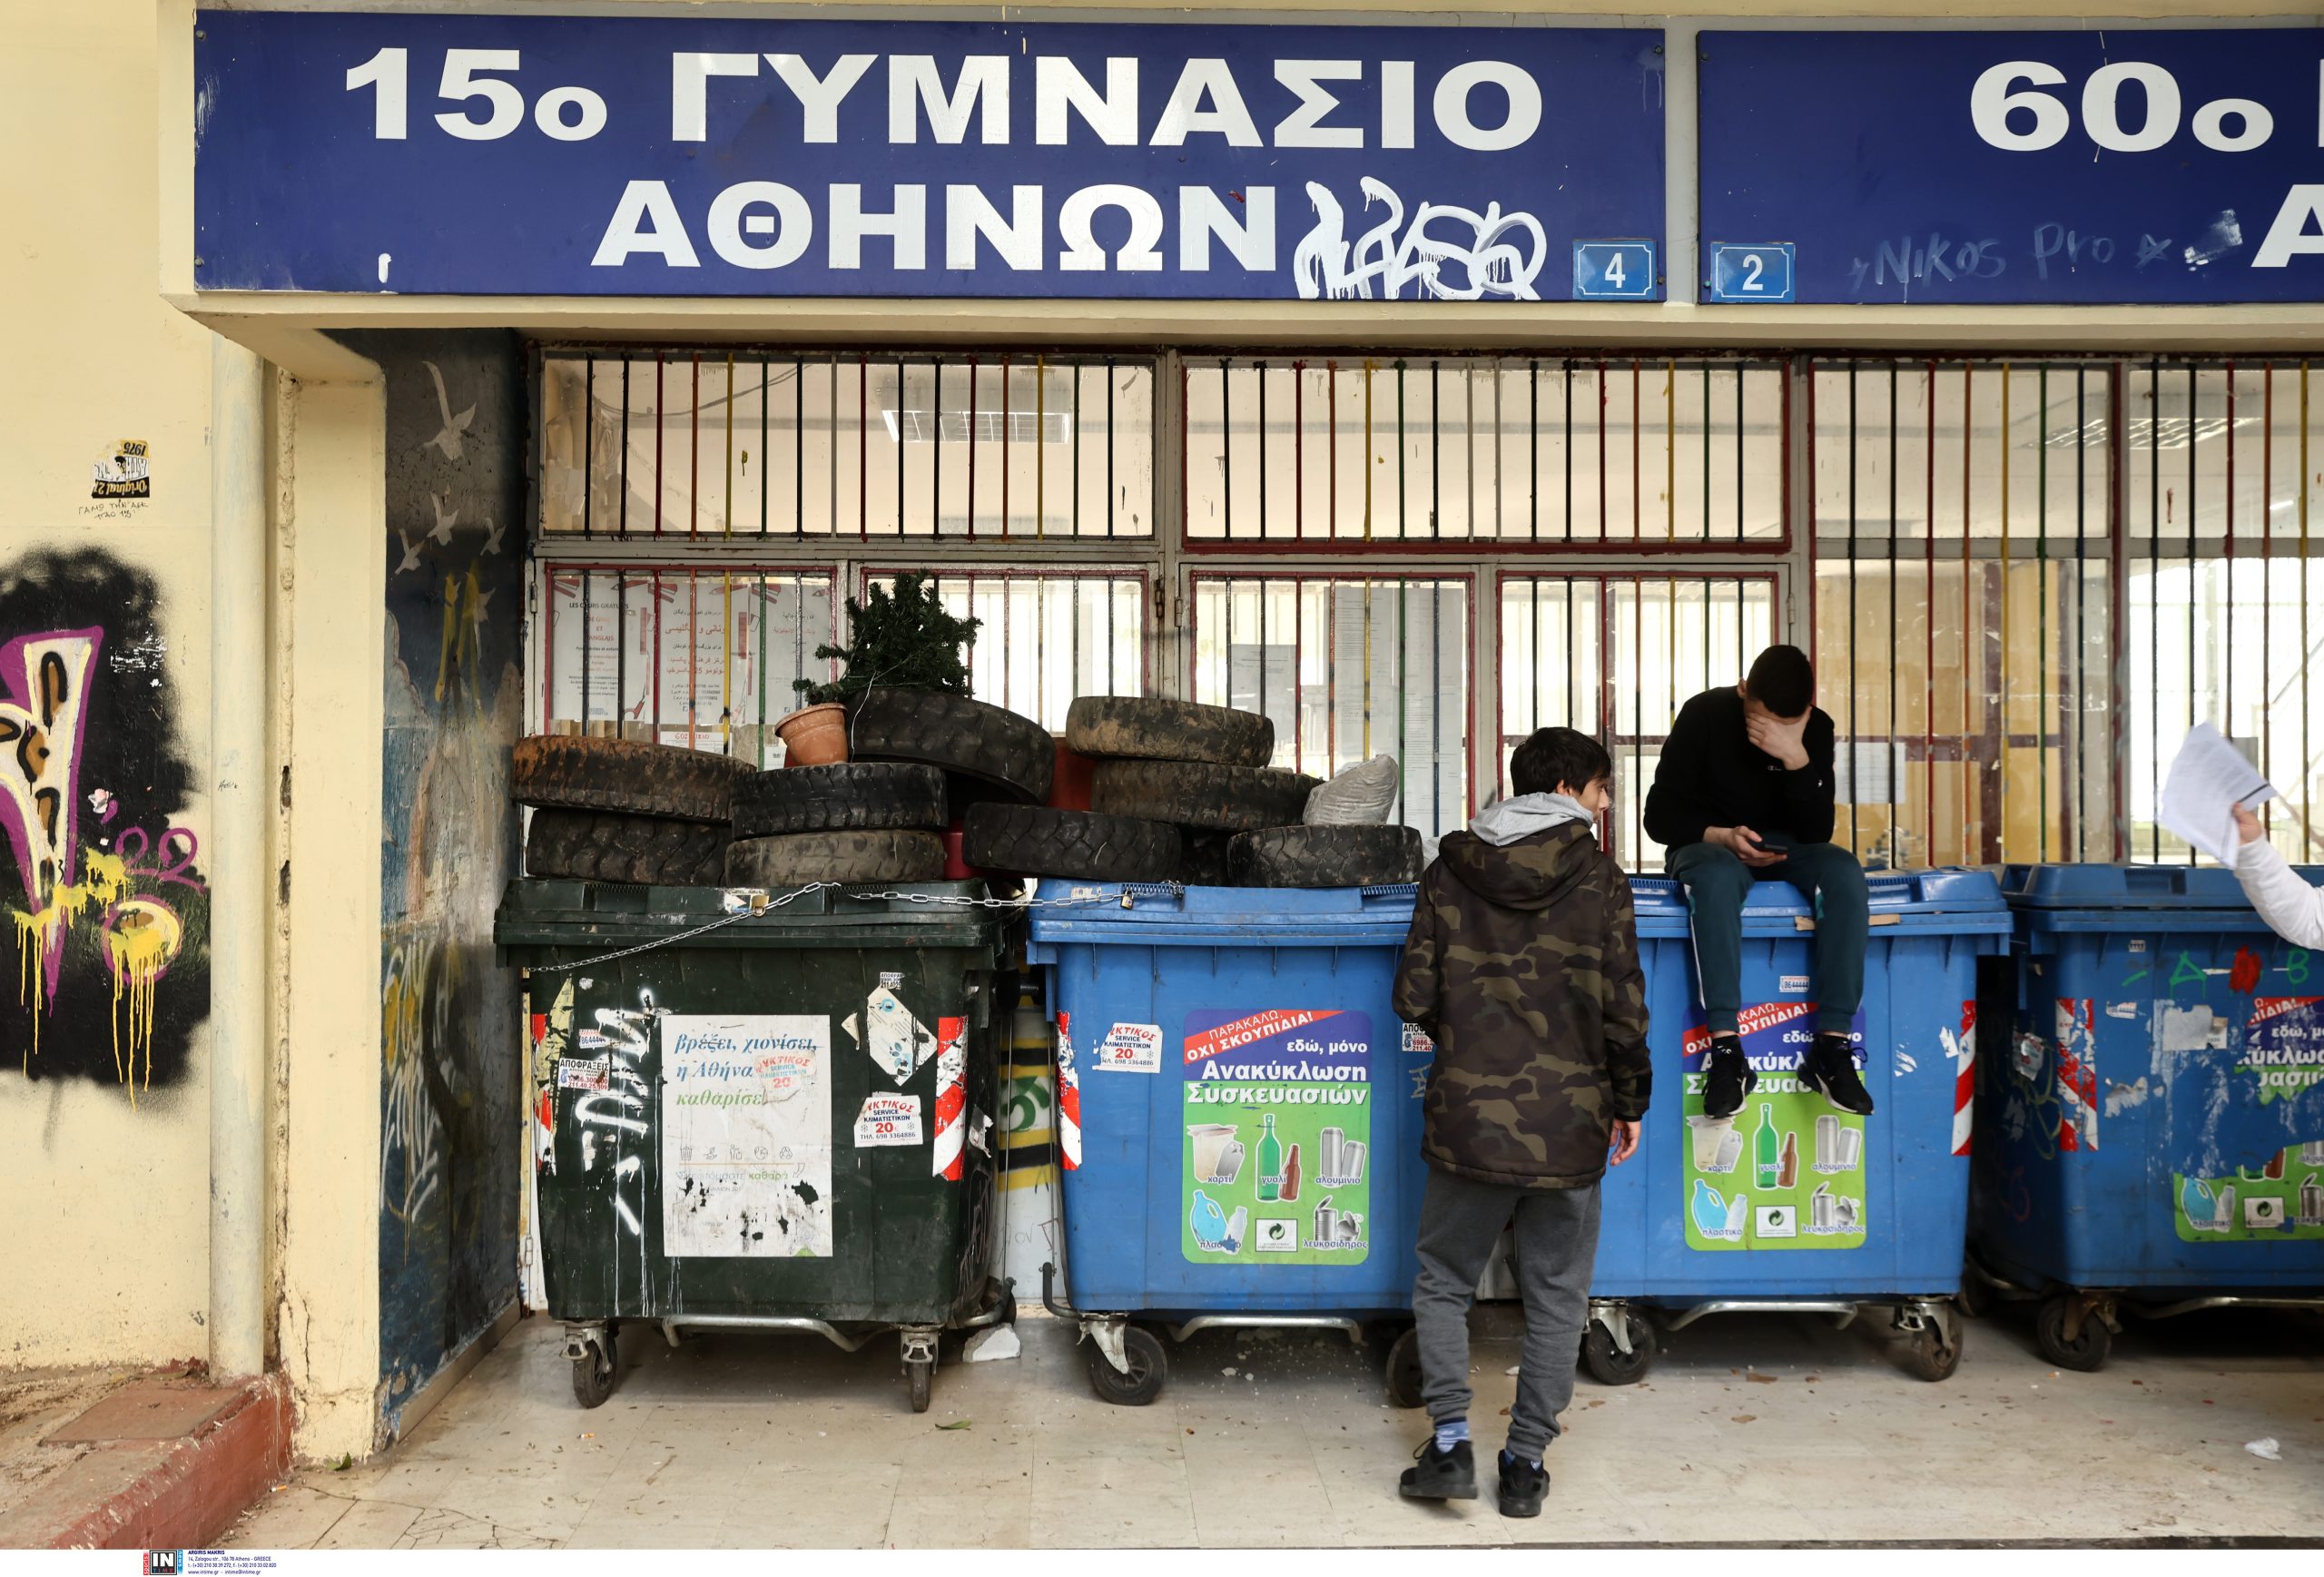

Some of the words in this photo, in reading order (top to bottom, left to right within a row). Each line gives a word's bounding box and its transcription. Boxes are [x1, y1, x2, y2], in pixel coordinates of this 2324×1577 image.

[672, 52, 1542, 151] ΓΥΜΝΑΣΙΟ
[590, 180, 1275, 271] ΑΘΗΝΩΝ
[1604, 252, 1626, 289] 4
[1741, 254, 1764, 291] 2
[107, 479, 147, 496] Original
[1208, 1010, 1283, 1040] ΠΑΡΑΚΑΛΩ,
[1738, 1003, 1808, 1035] ΟΥΠΙΔΙΑ!
[674, 1033, 737, 1054] βρέξει,
[742, 1033, 817, 1054] χιονίσει,
[1187, 1043, 1216, 1061] ΟΧΙ
[1219, 1011, 1314, 1050] ΣΚΟΥΠΙΔΙΑ!
[1286, 1039, 1324, 1054] εδώ,
[1328, 1040, 1367, 1055] μόνο
[560, 1059, 609, 1071] ΑΠΟΦΡΑΞΕΙΣ
[676, 1064, 688, 1081] η
[692, 1060, 753, 1081] Αθήνα
[1201, 1060, 1366, 1081] Ανακύκλωση
[676, 1089, 763, 1109] καθαρίσε
[1187, 1082, 1368, 1105] Συσκευασιών
